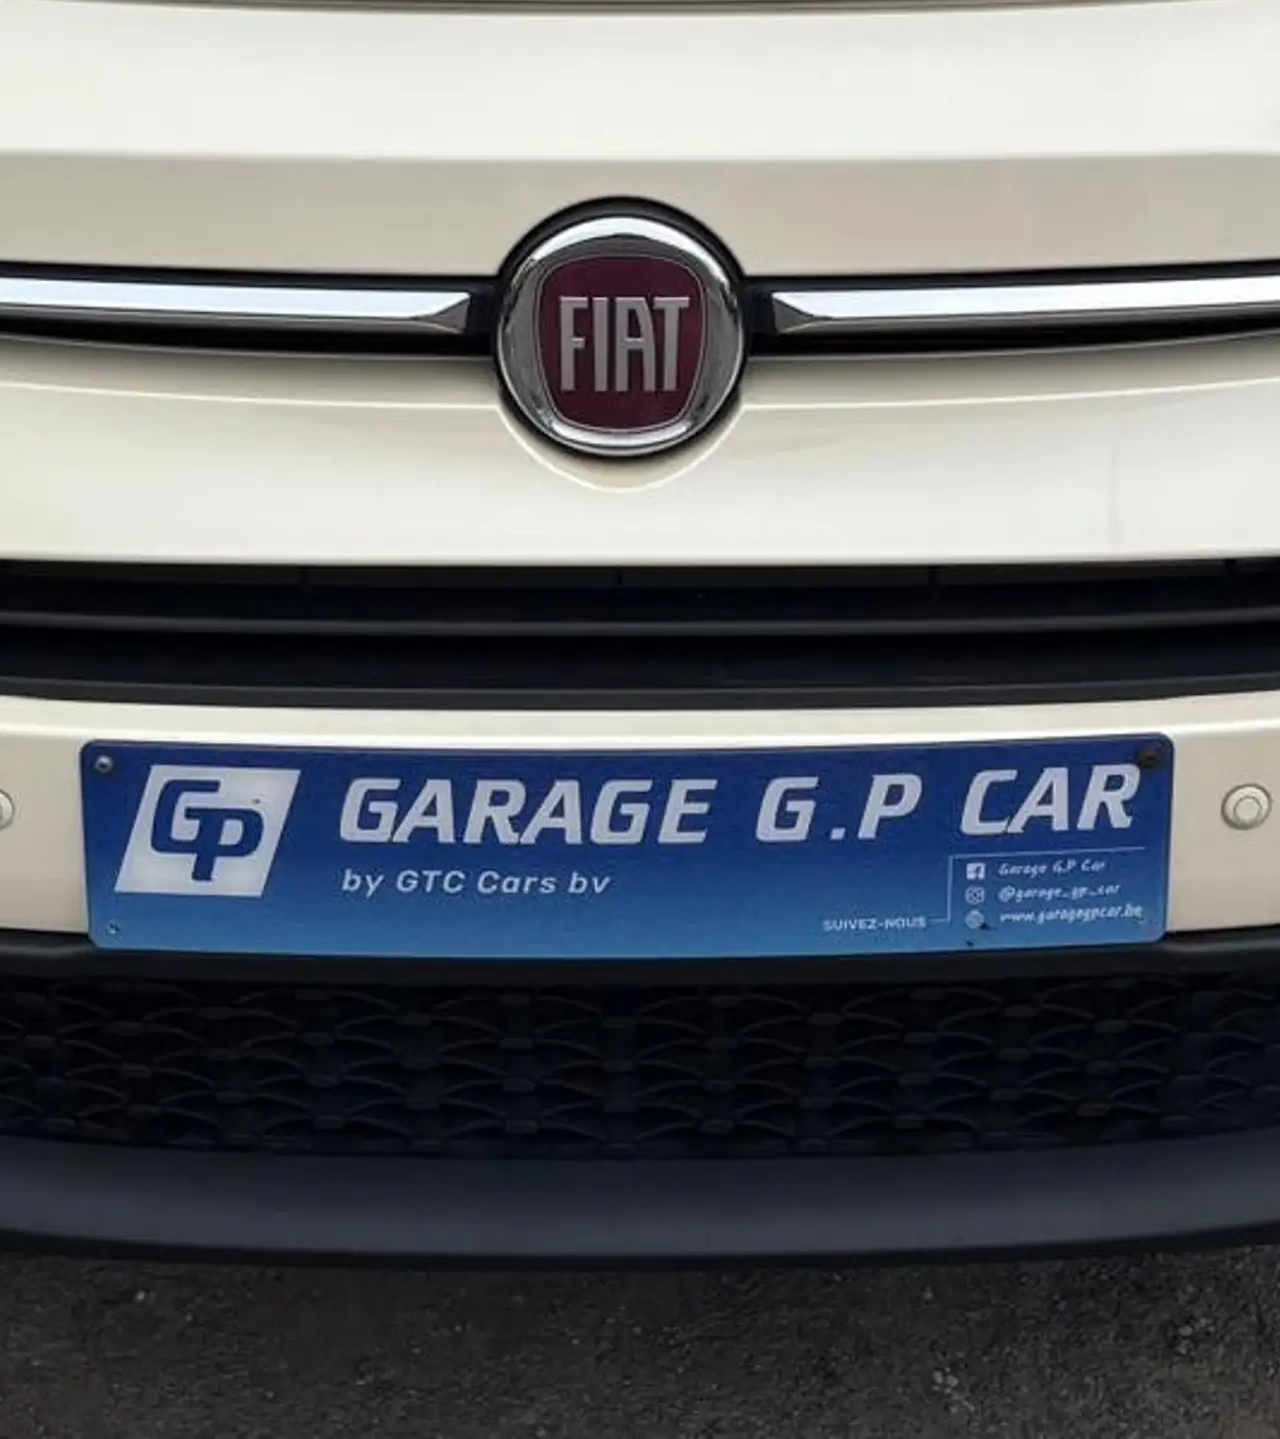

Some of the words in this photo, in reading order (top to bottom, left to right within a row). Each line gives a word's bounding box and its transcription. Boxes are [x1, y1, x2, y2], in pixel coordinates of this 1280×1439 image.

[559, 296, 690, 392] FIAT
[339, 777, 717, 845] GARAGE
[756, 773, 922, 842] G.P
[960, 764, 1141, 837] CAR
[342, 869, 384, 898] by
[397, 870, 464, 895] GTC
[476, 870, 557, 895] Cars
[568, 871, 612, 895] bv
[823, 916, 926, 932] SUIVEZ-NOUS
